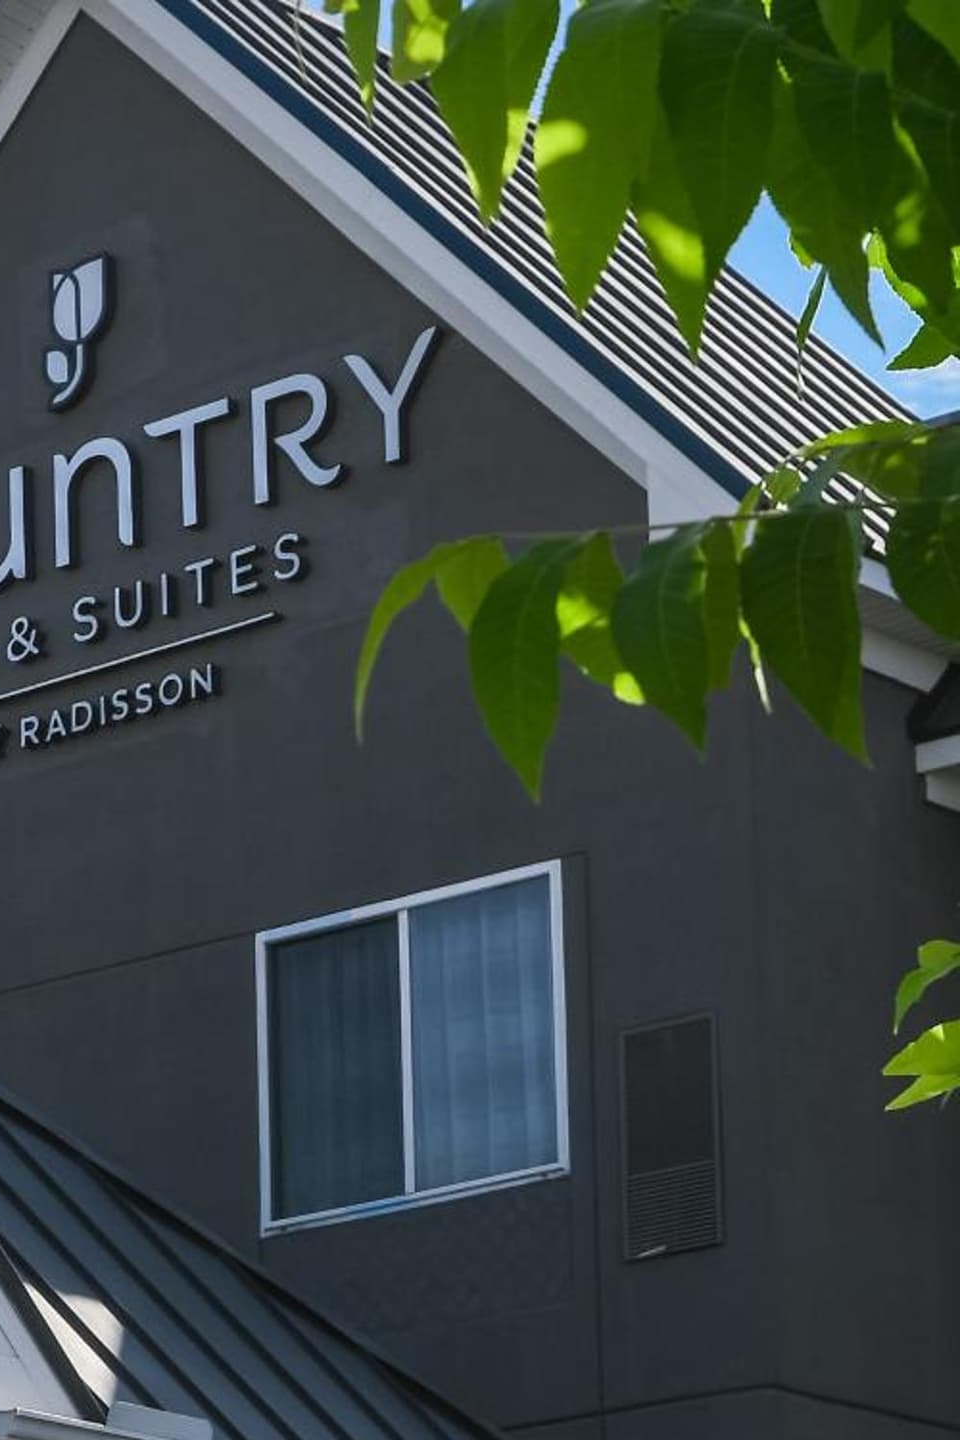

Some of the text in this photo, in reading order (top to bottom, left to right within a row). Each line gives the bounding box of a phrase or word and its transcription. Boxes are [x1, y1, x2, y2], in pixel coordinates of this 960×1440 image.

[6, 616, 39, 662] &
[73, 533, 302, 642] SUITES
[20, 663, 215, 747] RADISSON
